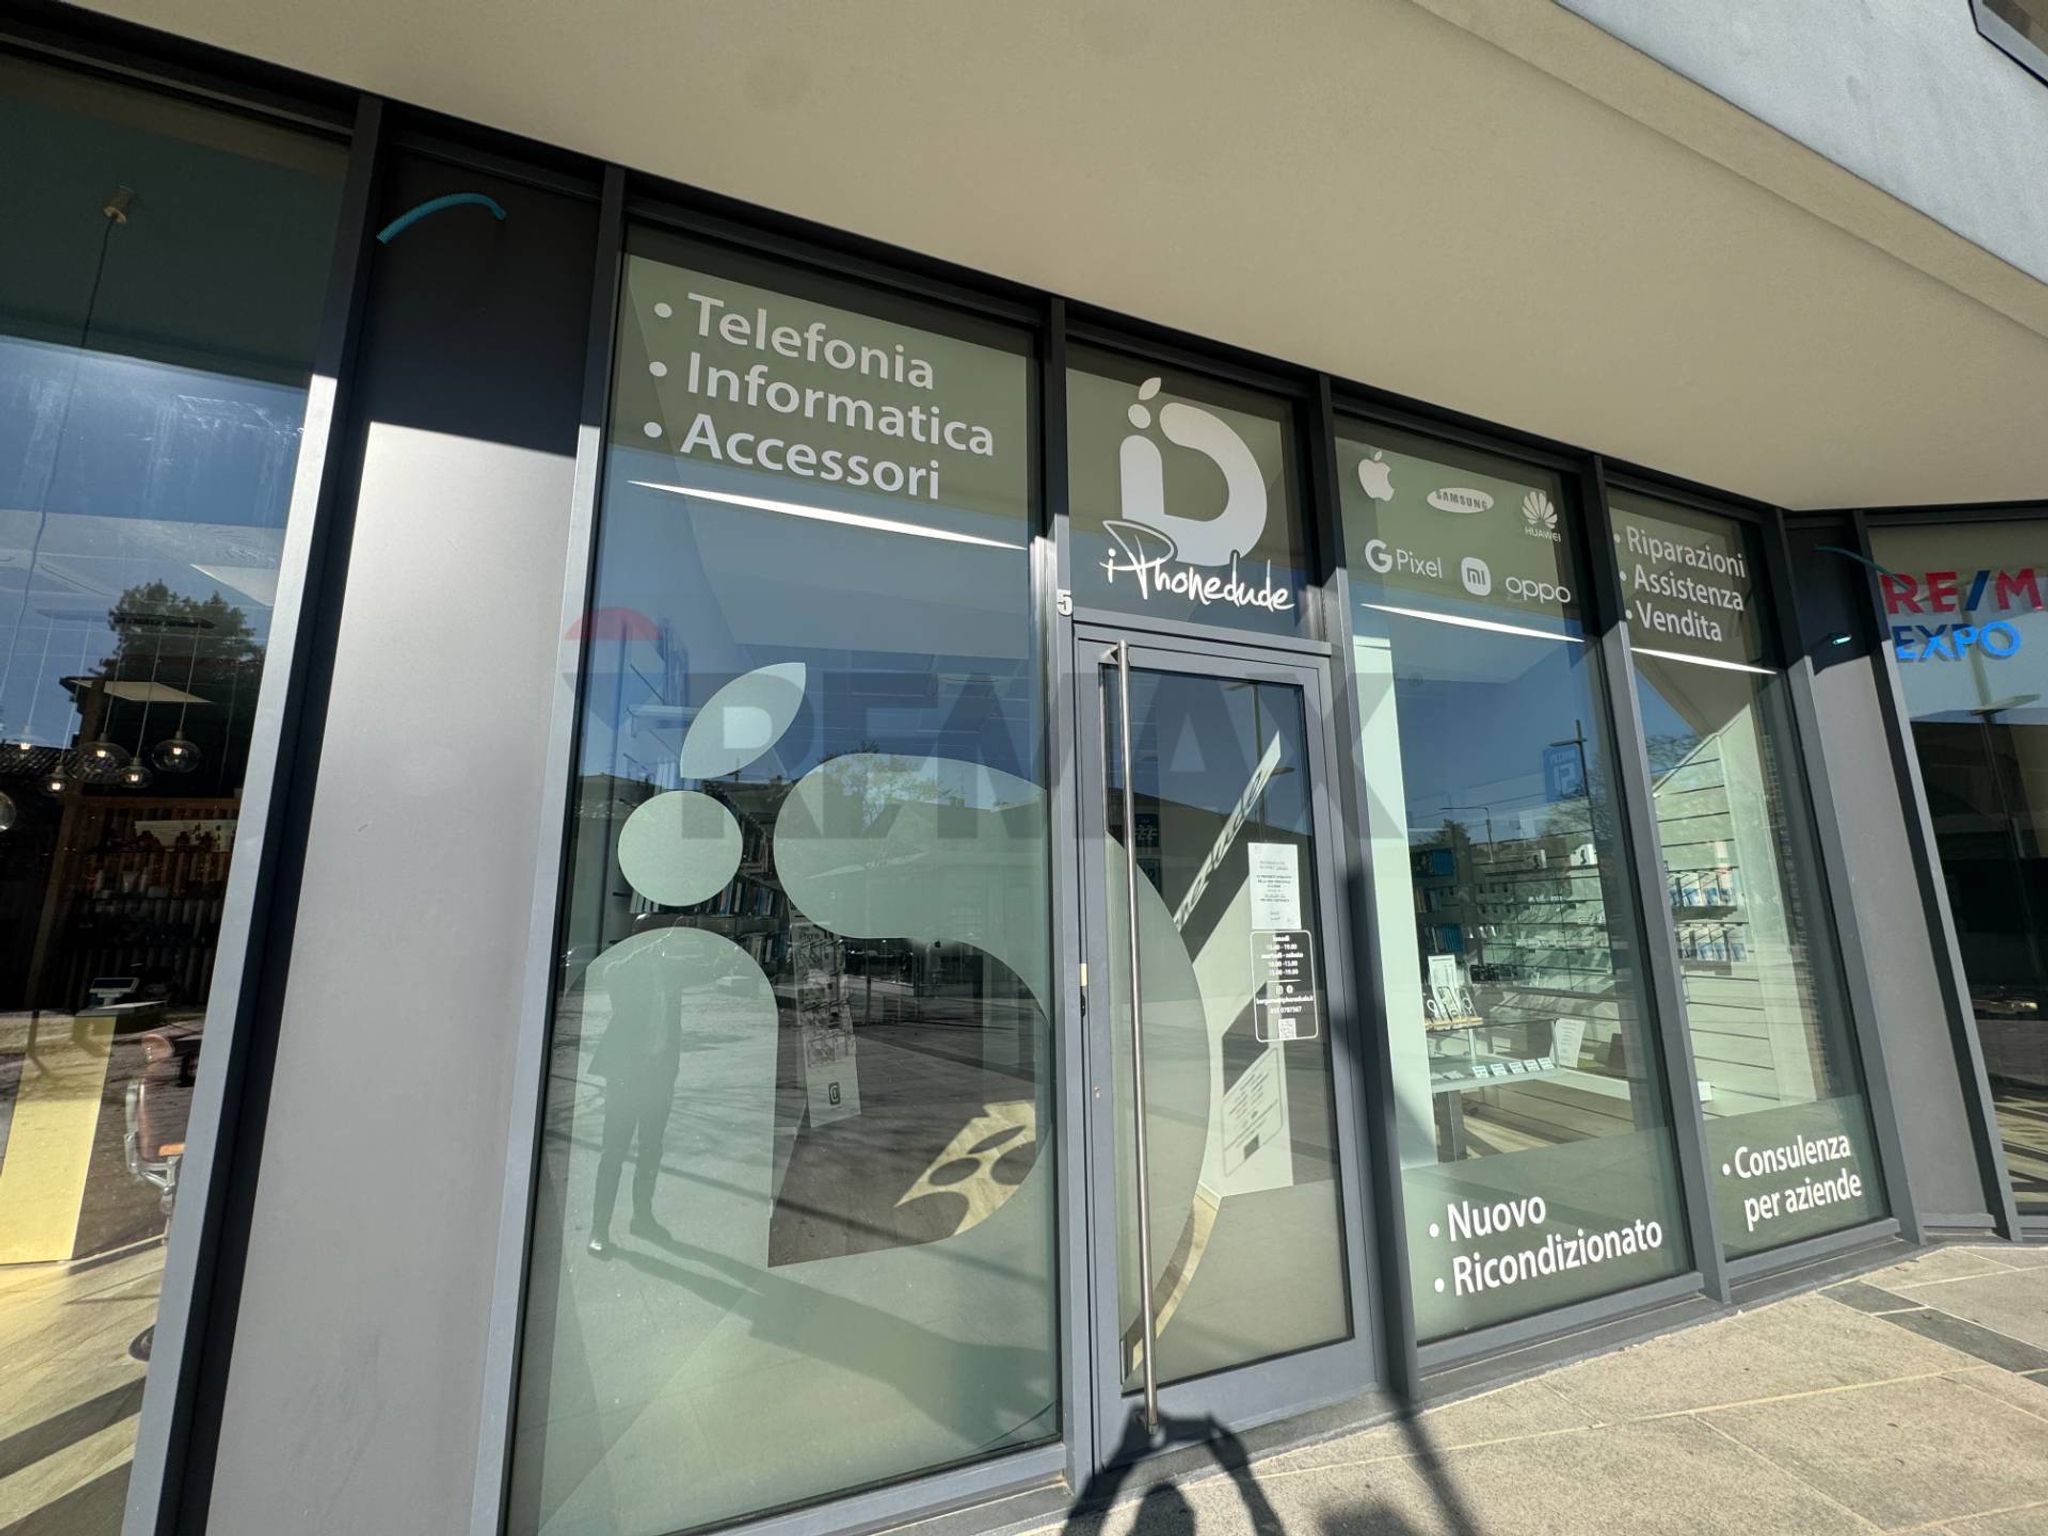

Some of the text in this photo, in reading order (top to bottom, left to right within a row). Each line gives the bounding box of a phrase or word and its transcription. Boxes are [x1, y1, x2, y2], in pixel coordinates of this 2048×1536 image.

[688, 292, 934, 390] Telefonia
[688, 352, 993, 456] Informatica
[680, 414, 938, 499] Accessori
[1435, 489, 1488, 511] SAMSUNG
[1524, 526, 1561, 542] HUAWEI
[1627, 525, 1746, 578] Riparazioni
[1396, 549, 1442, 578] Pixel
[1056, 589, 1073, 616] 5
[1634, 565, 1744, 612] Assistenza
[1880, 568, 2048, 614] RE/M
[1636, 601, 1722, 643] Vendita
[1891, 620, 2022, 662] EXPO
[1735, 1133, 1851, 1179] Consulenza
[1447, 1196, 1547, 1242] Nuovo
[1744, 1171, 1862, 1231] per aziende
[1453, 1218, 1663, 1297] Ricondizionato
